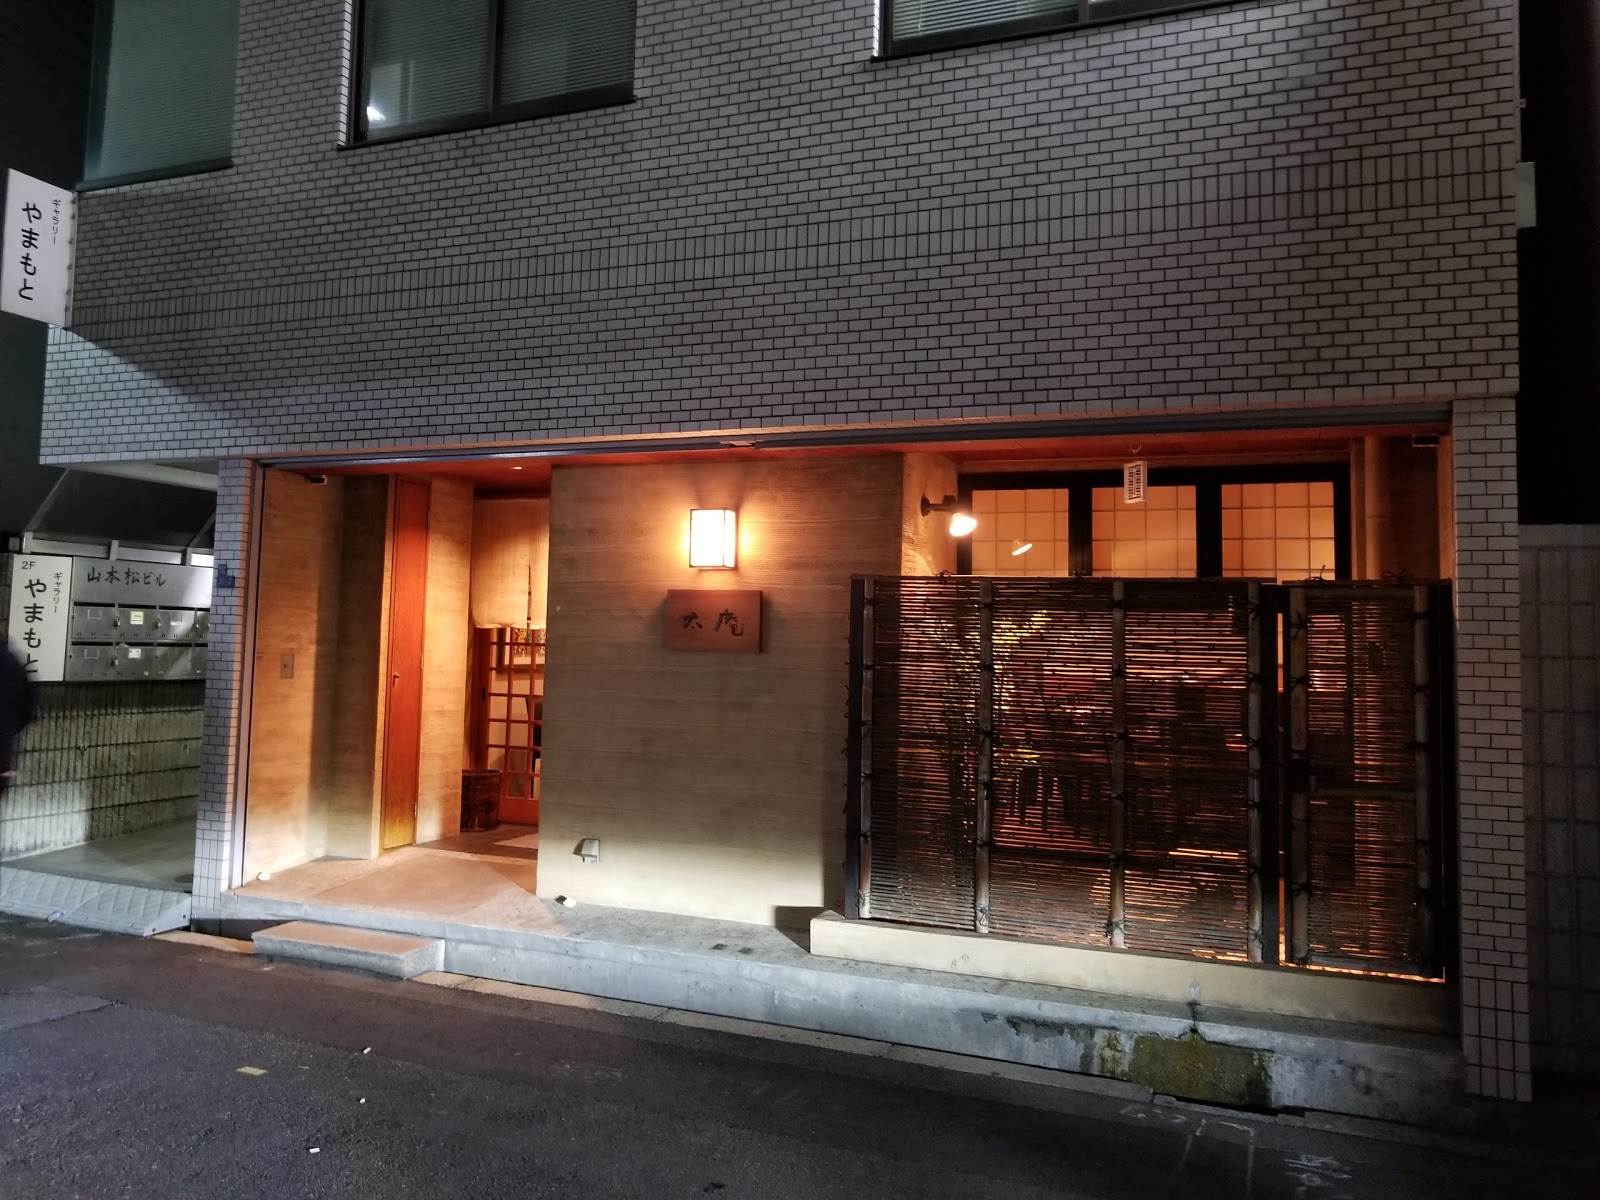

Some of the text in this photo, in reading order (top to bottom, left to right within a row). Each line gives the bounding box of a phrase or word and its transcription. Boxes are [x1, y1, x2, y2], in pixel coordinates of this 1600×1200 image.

[52, 198, 61, 245] ギャラリー
[18, 202, 42, 301] やまもと
[21, 560, 36, 570] 2F
[87, 565, 166, 587] 山本松ビル
[53, 572, 62, 613] ギャラリー
[23, 578, 47, 673] やまもと
